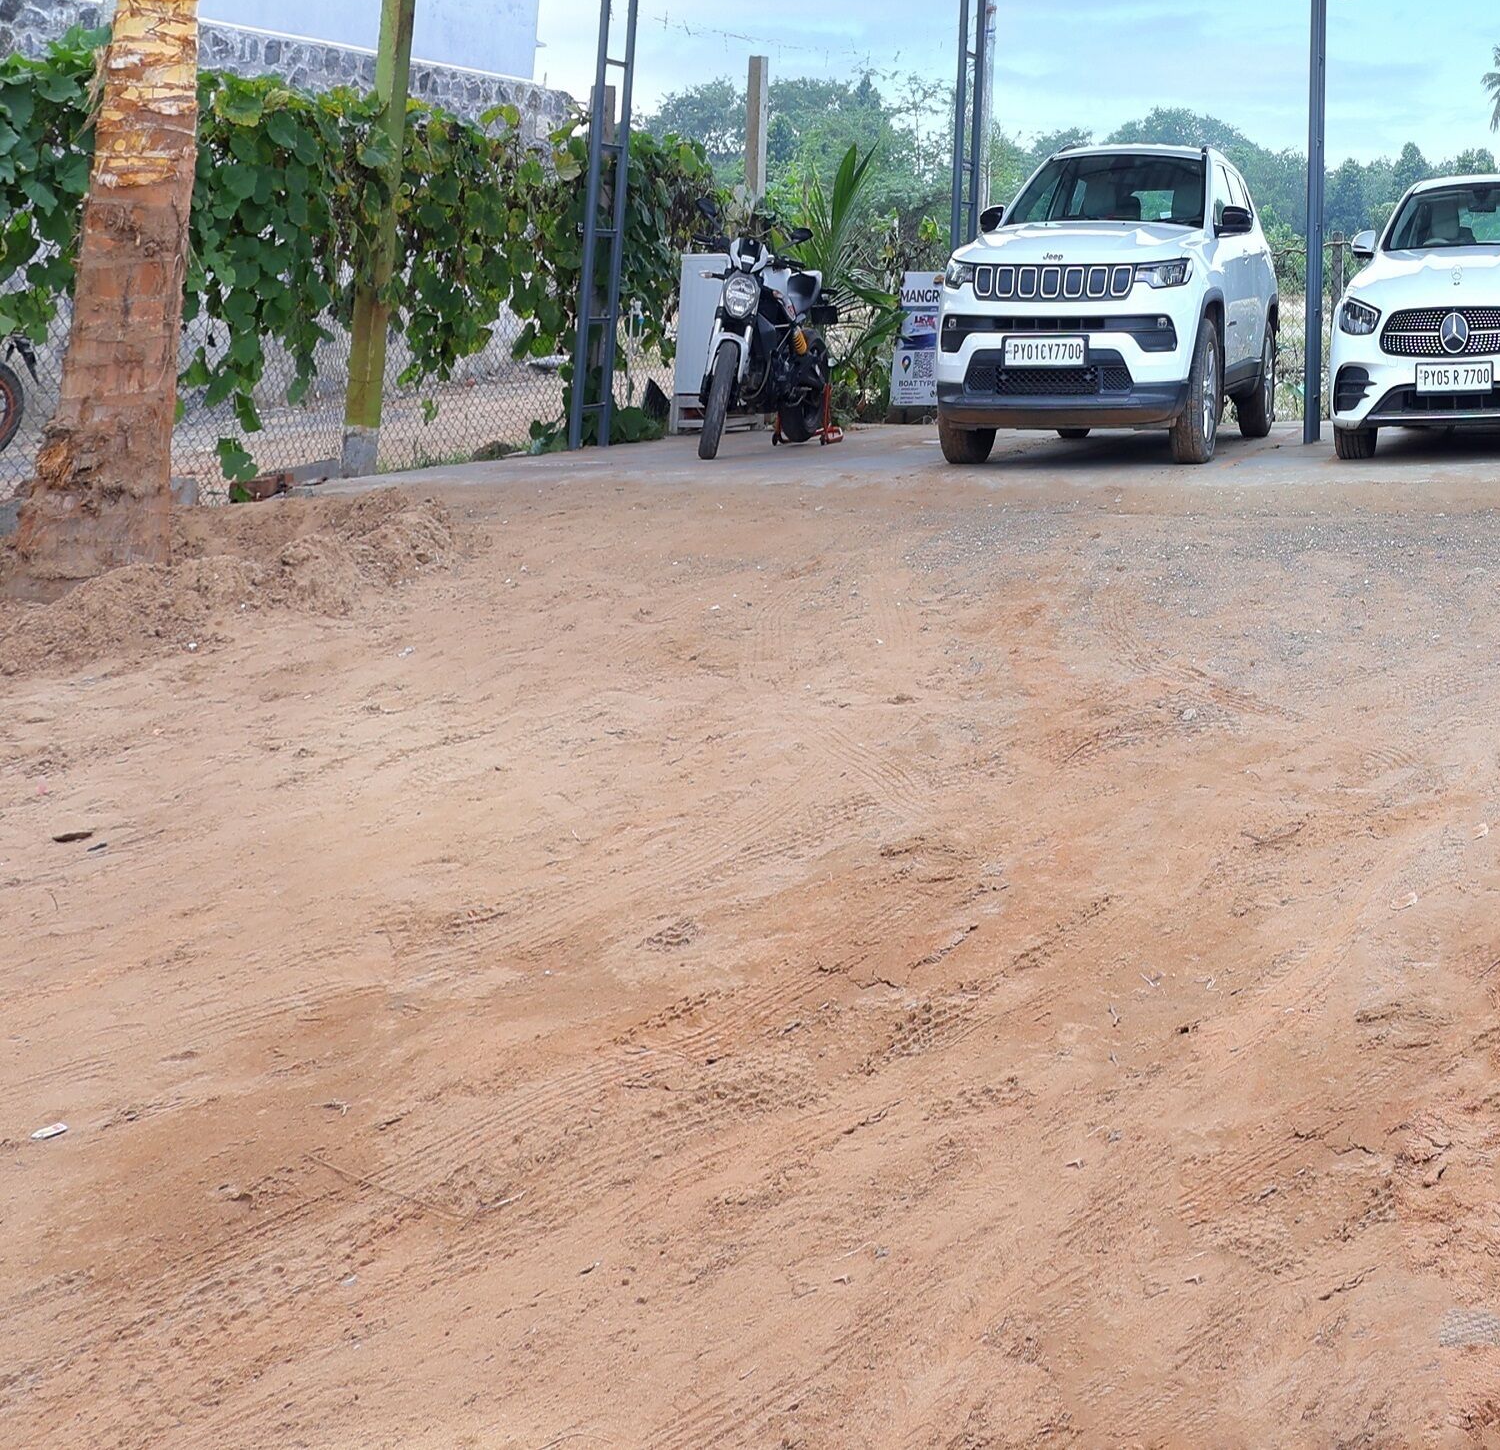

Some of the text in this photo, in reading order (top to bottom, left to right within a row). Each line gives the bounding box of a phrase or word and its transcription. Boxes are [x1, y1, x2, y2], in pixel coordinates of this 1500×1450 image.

[1043, 252, 1063, 261] Jeep
[901, 289, 940, 302] MANGR
[1013, 343, 1081, 360] PY01CY7700
[1424, 368, 1489, 385] PY05 R 7700
